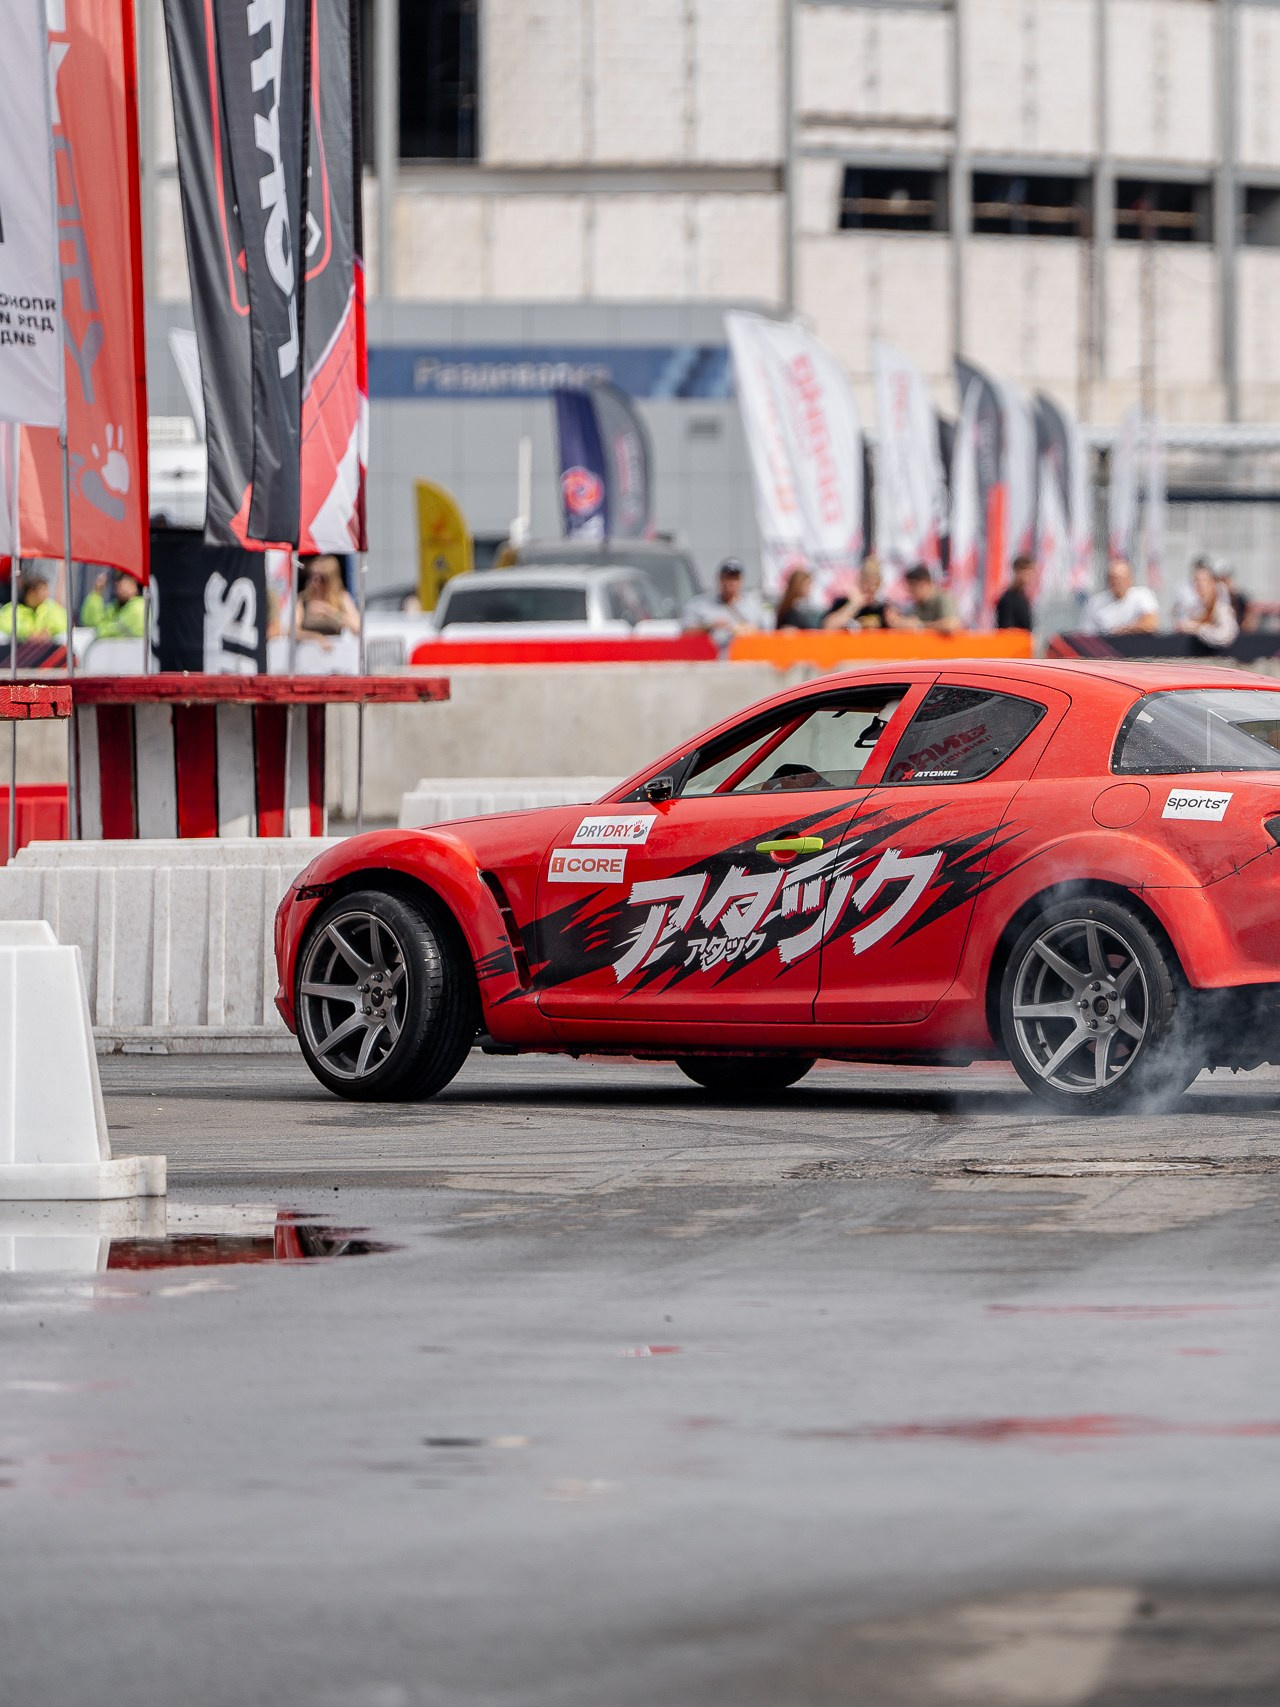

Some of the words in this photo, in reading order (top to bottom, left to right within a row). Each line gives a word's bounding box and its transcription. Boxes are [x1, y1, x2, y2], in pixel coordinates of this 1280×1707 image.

[914, 770, 959, 778] ATOMIC
[576, 825, 634, 838] DRYDRY
[611, 847, 945, 984] アタック
[683, 931, 768, 972] アタック
